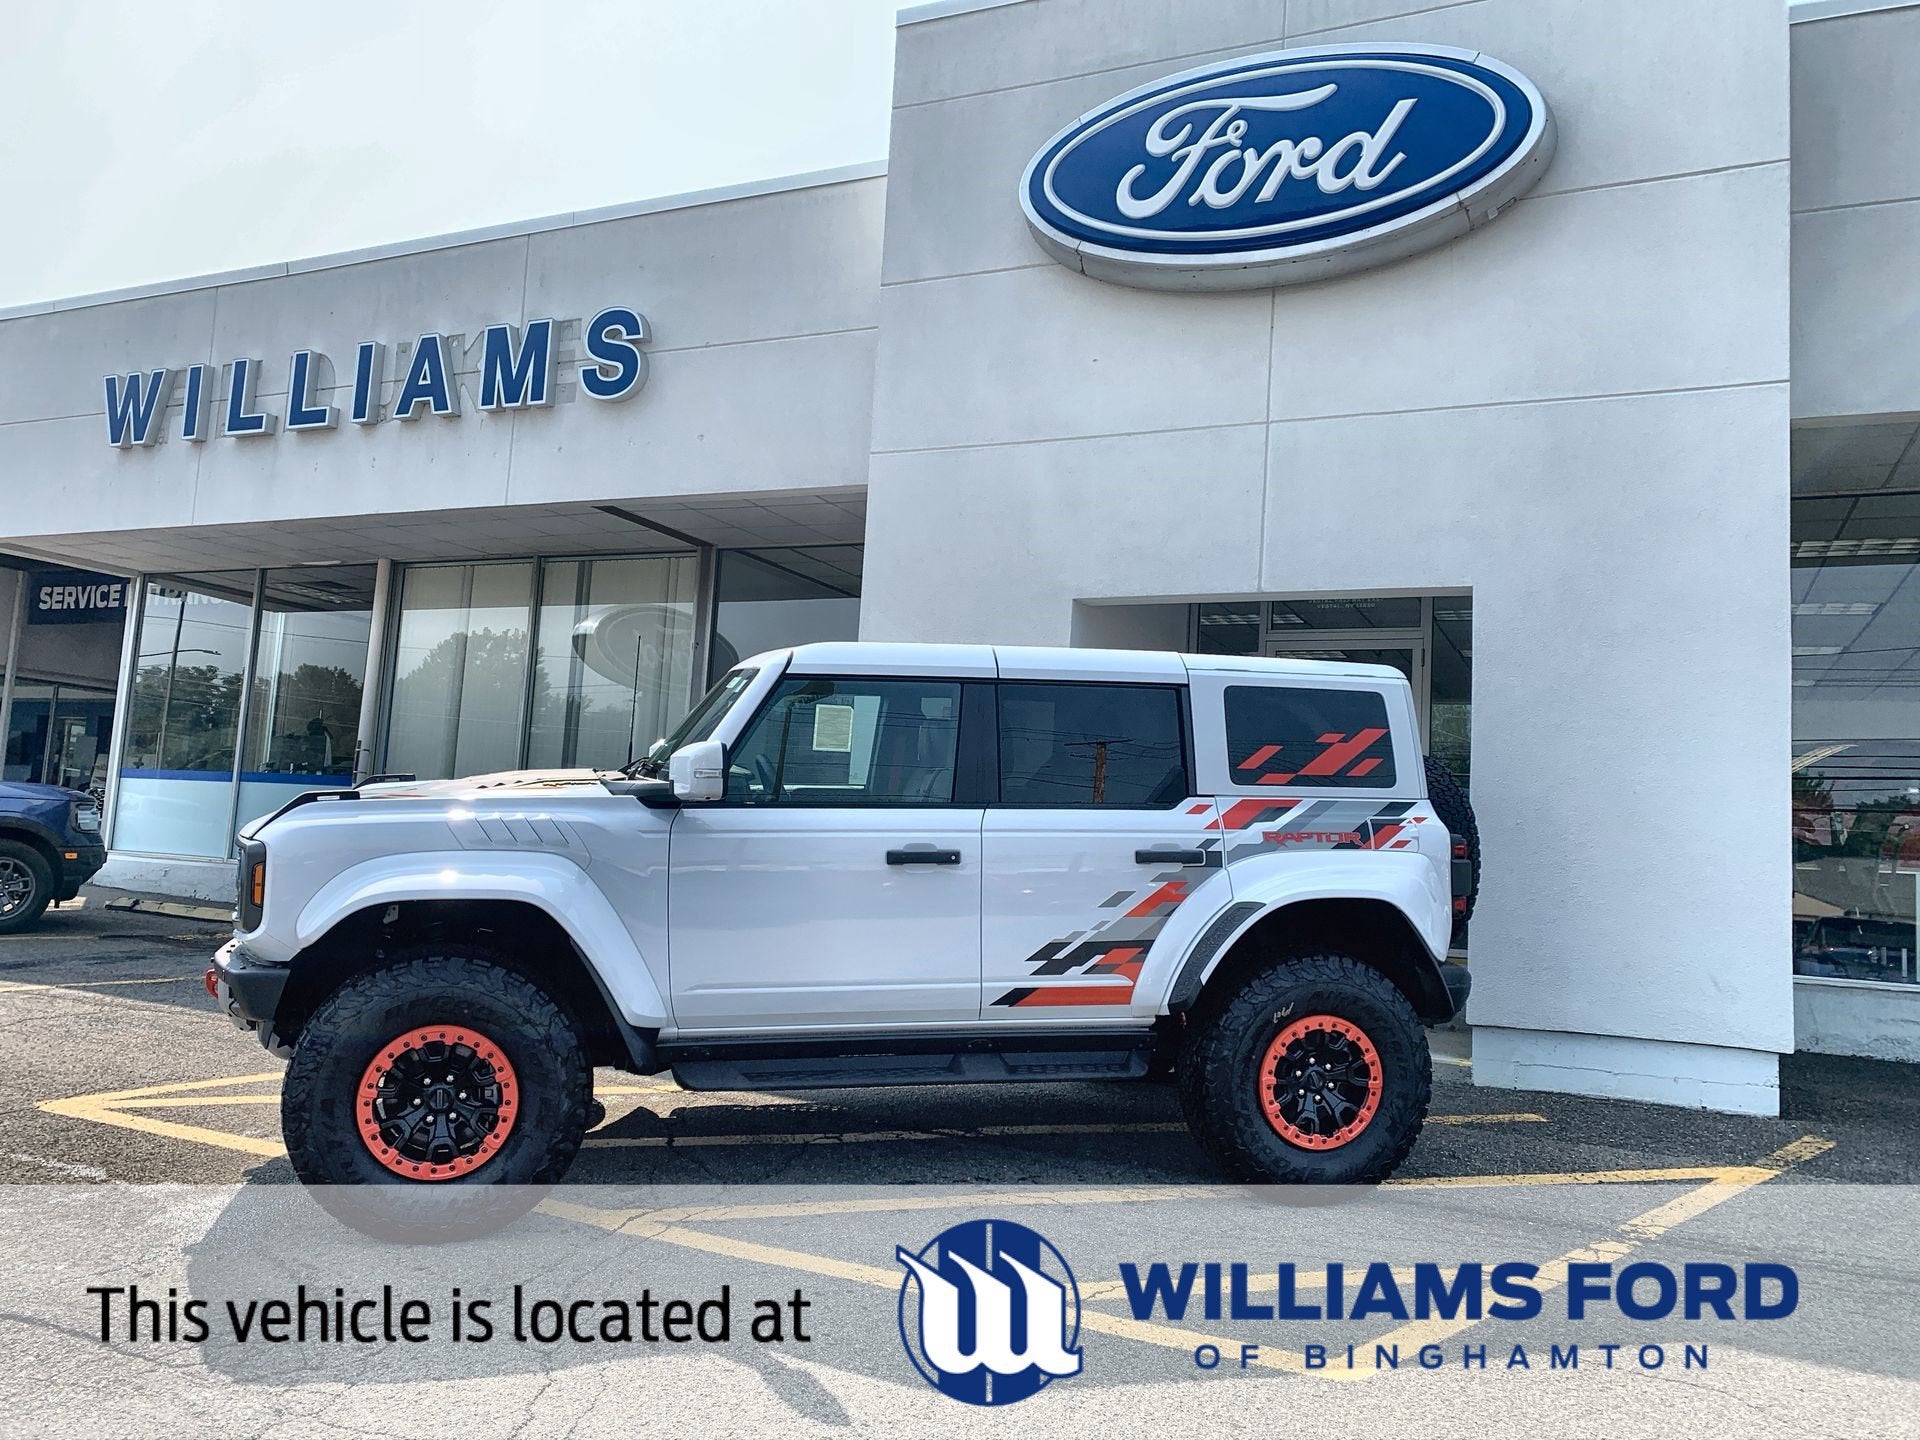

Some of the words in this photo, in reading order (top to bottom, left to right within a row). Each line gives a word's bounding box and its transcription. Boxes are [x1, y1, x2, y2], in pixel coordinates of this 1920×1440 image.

[1116, 83, 1418, 220] Ford
[103, 306, 648, 447] WILLIAMS
[38, 584, 121, 610] SERVICE
[1262, 831, 1366, 848] RAPTOR
